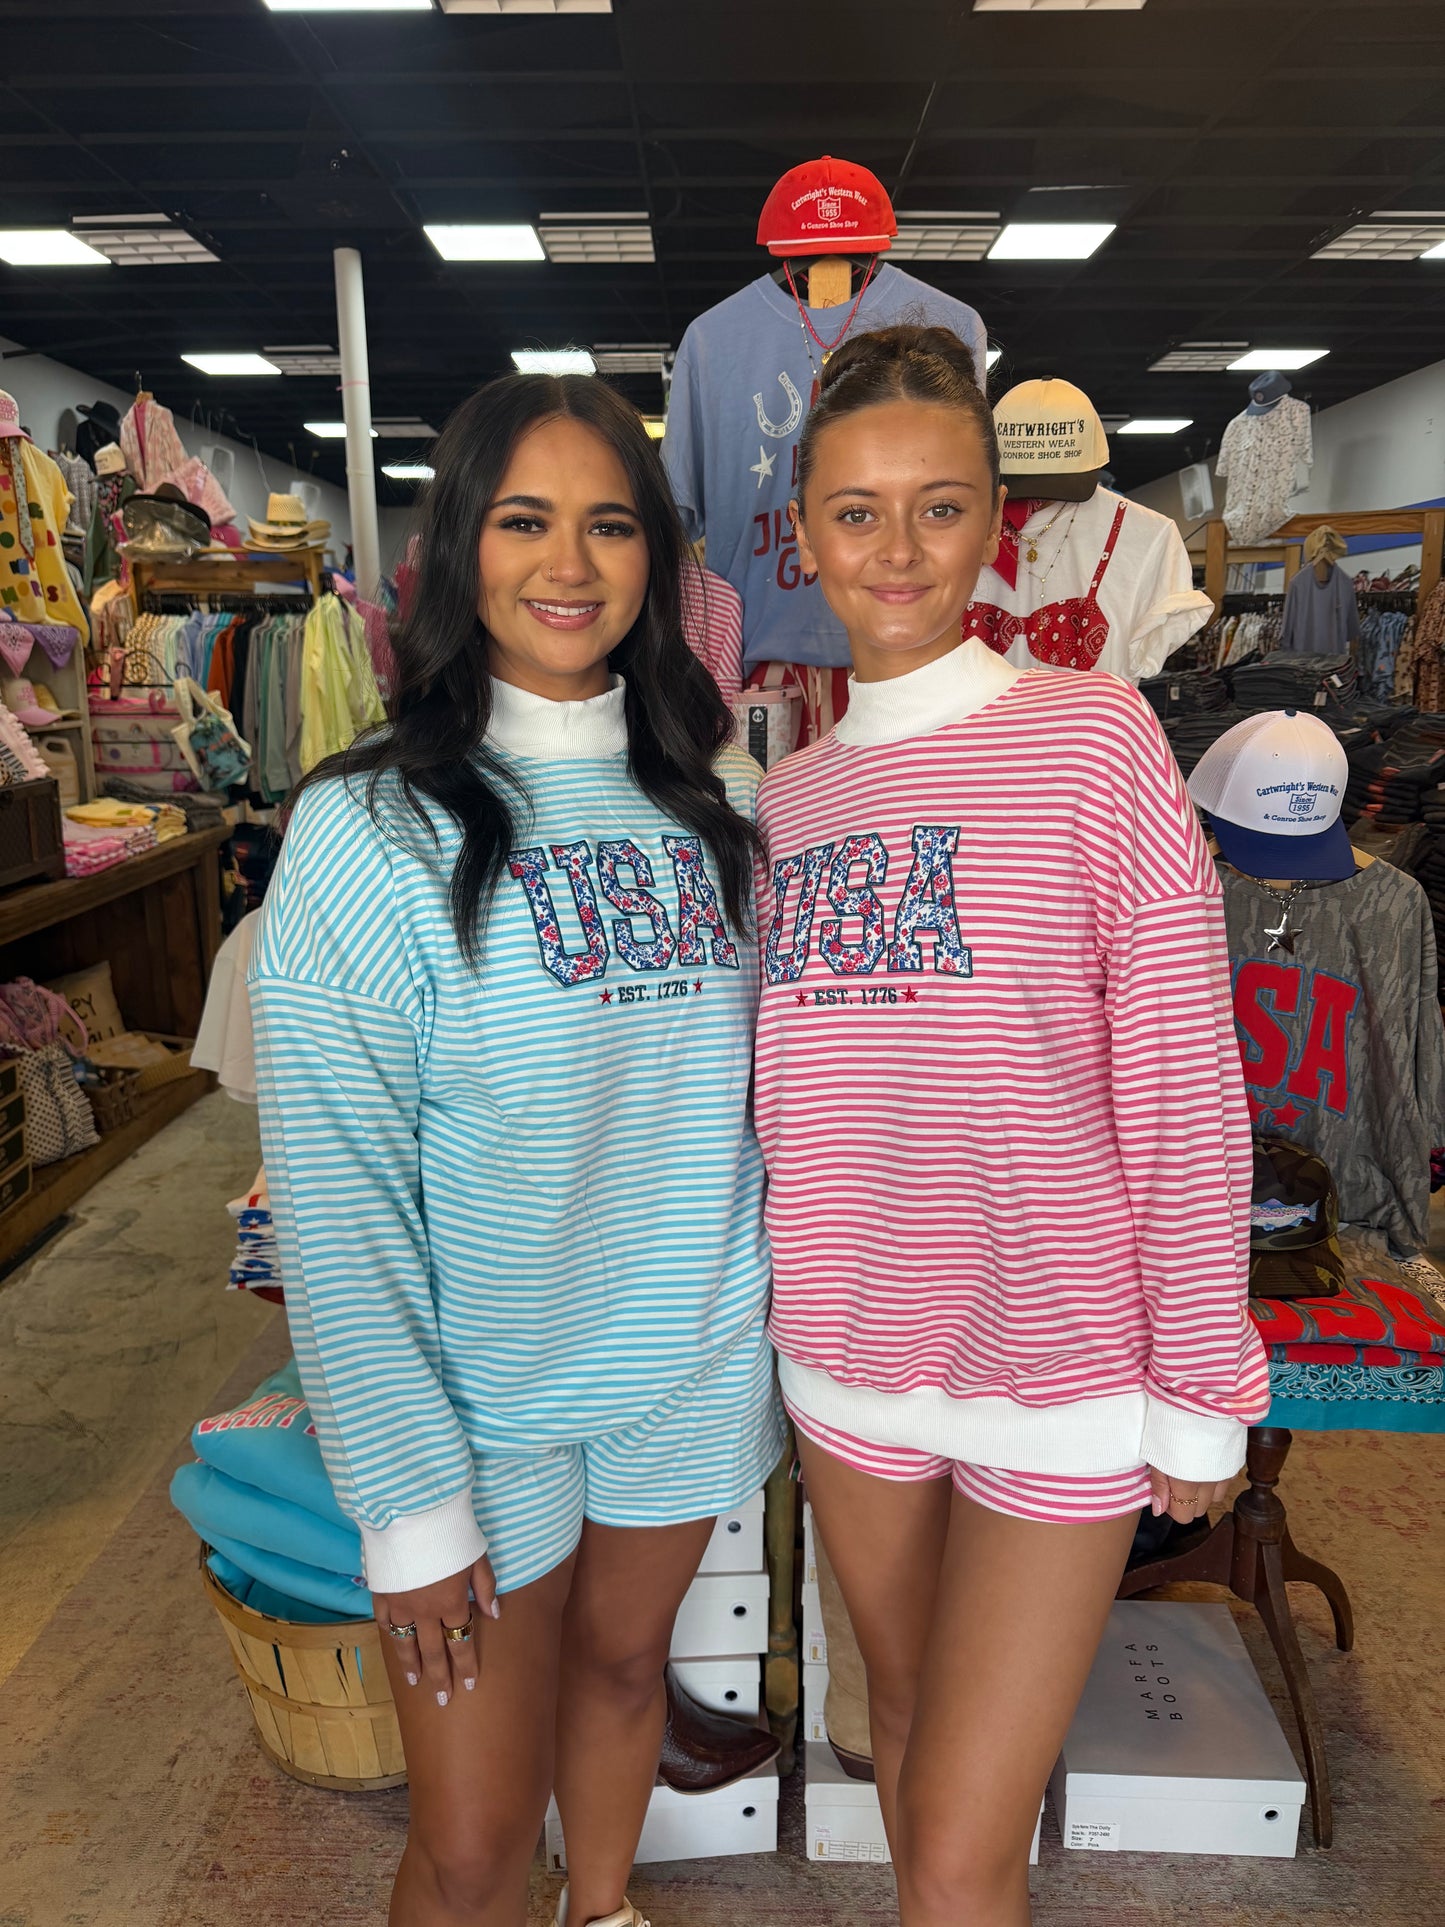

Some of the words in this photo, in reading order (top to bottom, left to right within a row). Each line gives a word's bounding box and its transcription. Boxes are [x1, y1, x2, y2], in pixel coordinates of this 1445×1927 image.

[791, 187, 827, 211] Cartwright's
[828, 186, 853, 199] Western
[854, 190, 868, 206] Wear
[822, 209, 838, 217] 1955
[829, 221, 844, 229] Shoe
[844, 220, 859, 228] Shop
[997, 419, 1085, 436] CARTWRIGHT'S
[1003, 440, 1045, 449] WESTERN
[1048, 439, 1076, 448] WEAR
[1003, 451, 1035, 459] CONROE
[1037, 451, 1061, 459] SHOE
[1063, 449, 1082, 458] SHOP
[1256, 782, 1305, 797] Cartwright's
[1307, 781, 1329, 793] Western
[1293, 804, 1310, 812] 1955
[507, 836, 740, 988] USA
[765, 825, 974, 986] USA
[618, 984, 650, 1004] EST.
[657, 980, 688, 1000] 1776
[813, 989, 853, 1006] EST.
[861, 987, 897, 1005] 1776
[1229, 957, 1363, 1120] SA
[1124, 1643, 1160, 1720] MARFA
[1145, 1644, 1184, 1720] BOOTS
